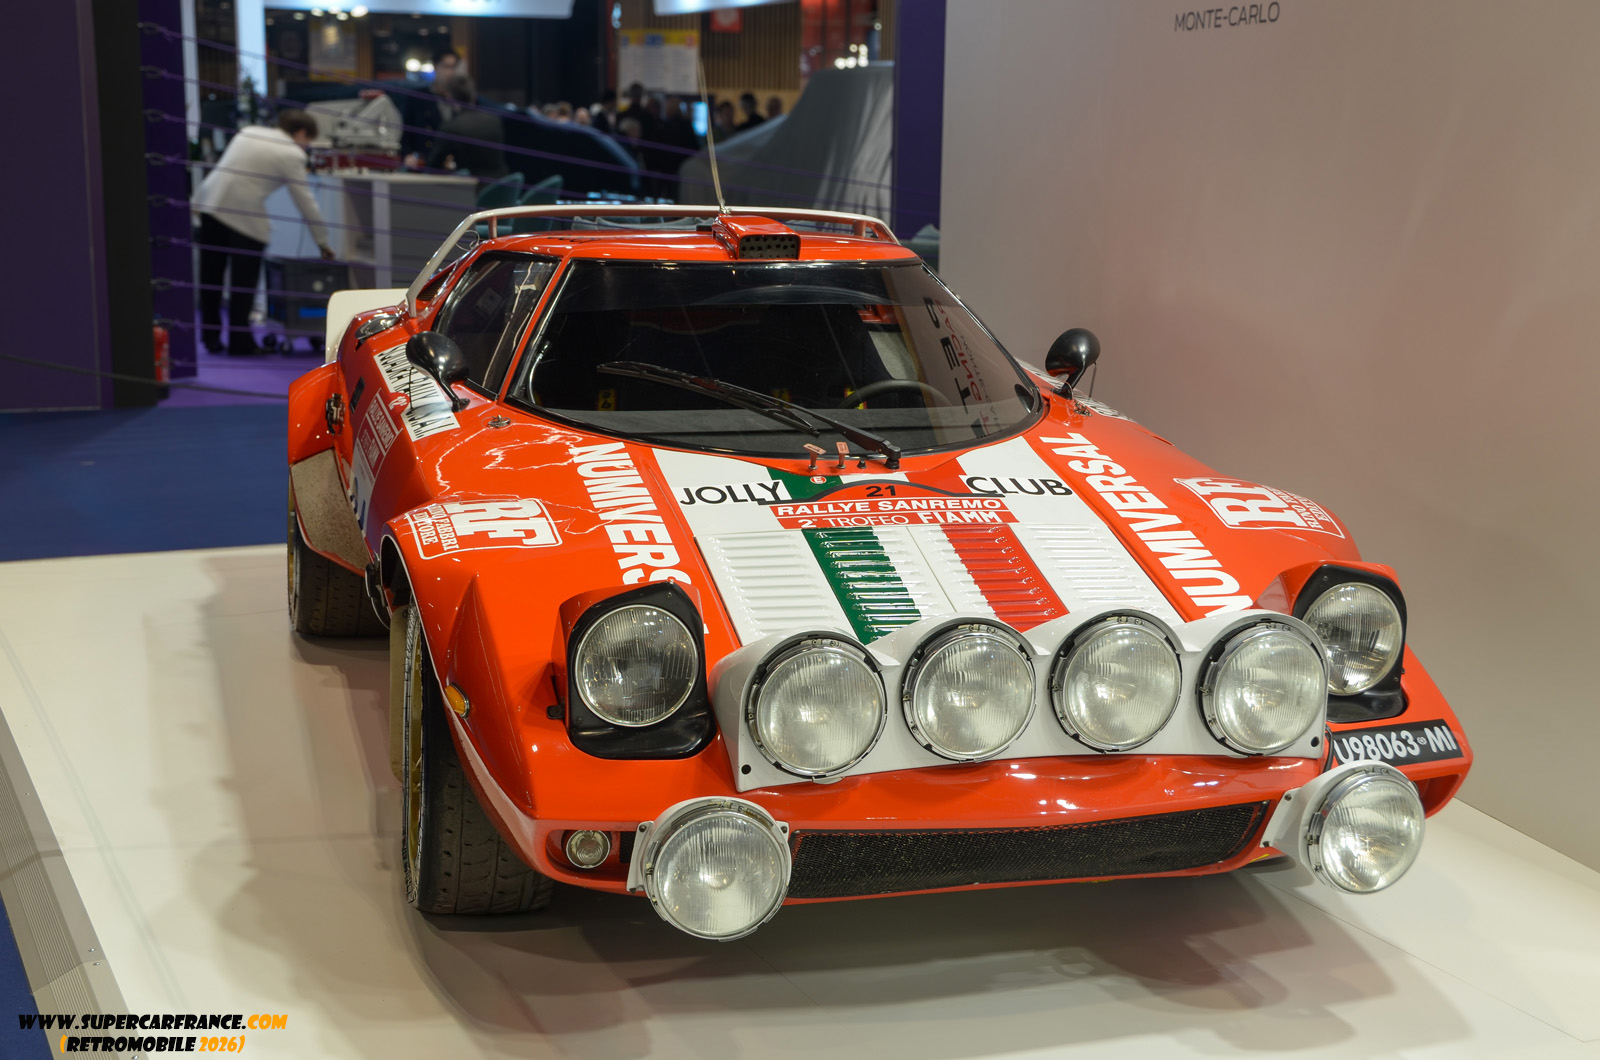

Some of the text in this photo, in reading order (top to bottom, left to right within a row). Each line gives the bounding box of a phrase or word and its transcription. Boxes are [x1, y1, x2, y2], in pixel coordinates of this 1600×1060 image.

[1174, 1, 1280, 32] MONTE-CARLO
[680, 476, 1073, 505] JOLLY CLUB
[777, 499, 1001, 516] RALLYE SANREMO
[866, 485, 897, 497] 21
[1184, 478, 1309, 528] RF
[412, 511, 439, 546] EDITORE
[443, 500, 557, 546] RF
[568, 442, 693, 587] NUMIVERS
[822, 516, 909, 528] TROFEO
[916, 511, 1000, 524] FIAMM
[1039, 432, 1254, 618] NUMIVERSAL
[1291, 504, 1324, 530] RINO
[435, 517, 460, 551] FABBRI
[1334, 725, 1458, 764] U98063 MI
